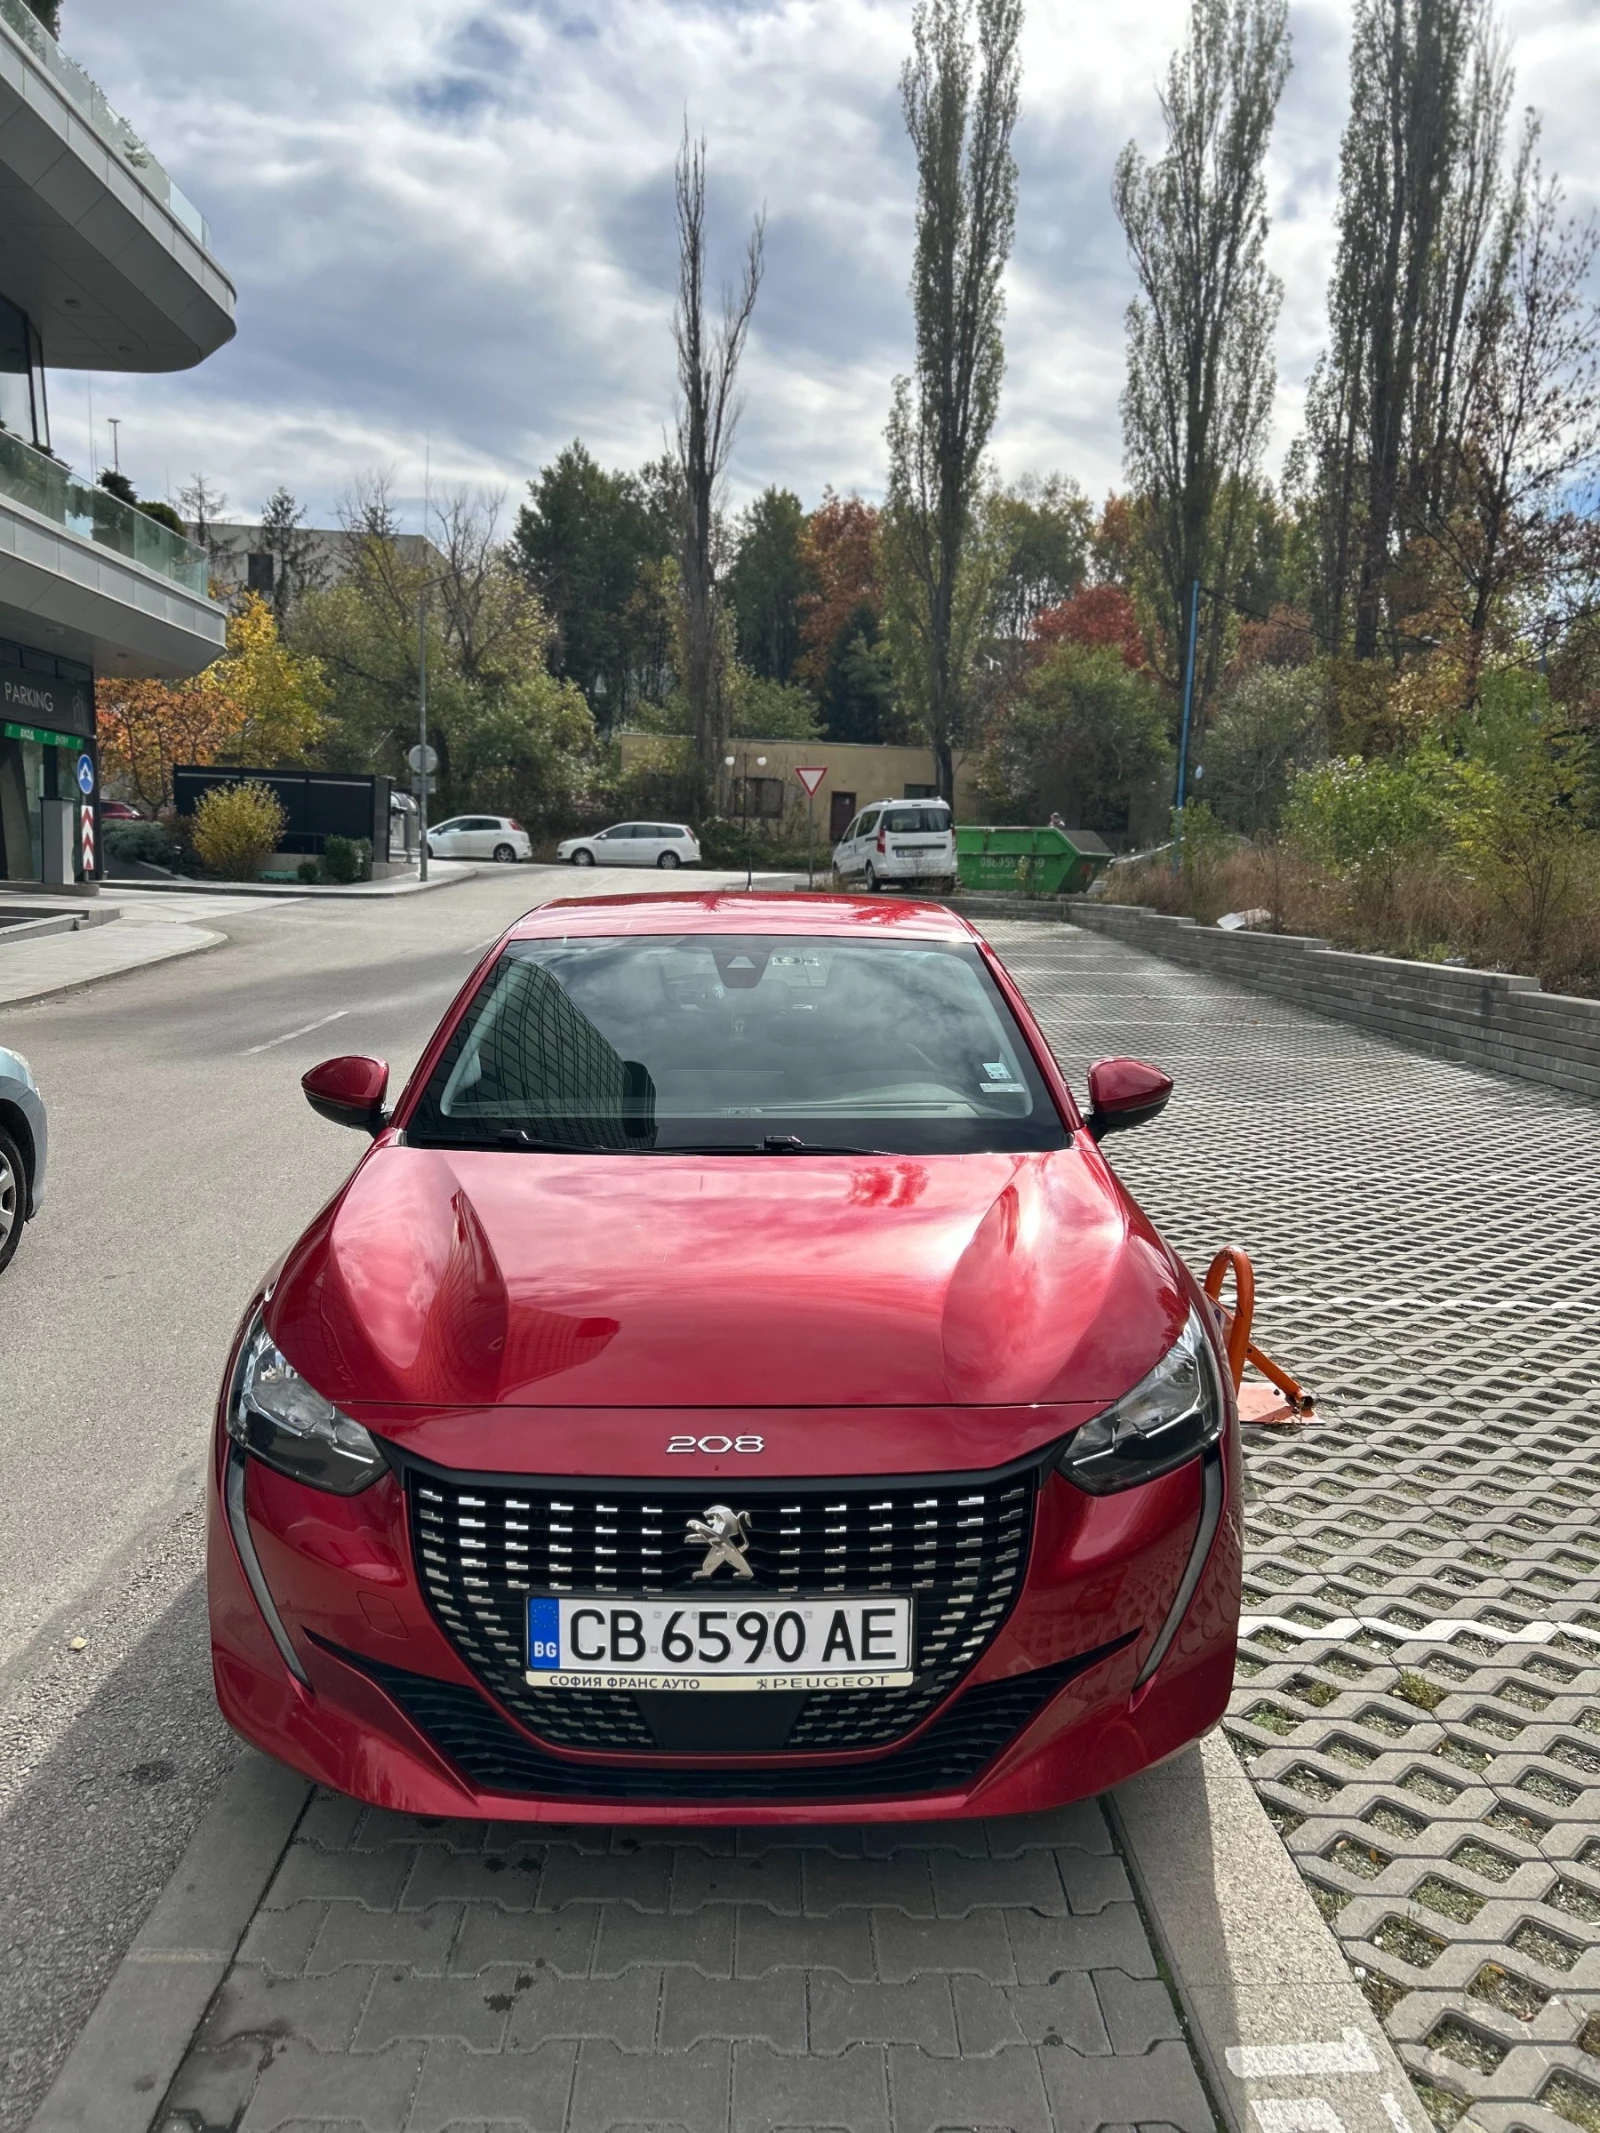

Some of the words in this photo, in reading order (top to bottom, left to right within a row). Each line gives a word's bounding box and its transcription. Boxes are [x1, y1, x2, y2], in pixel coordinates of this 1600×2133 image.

[5, 682, 53, 711] PARKING
[665, 1435, 765, 1455] 208
[570, 1608, 647, 1662] CB
[661, 1610, 806, 1663] 6590
[821, 1607, 897, 1662] AE
[533, 1641, 558, 1658] BG
[549, 1675, 603, 1688] СОФИЯ
[606, 1676, 659, 1690] ФРАНС
[661, 1678, 701, 1690] АУТО
[772, 1675, 890, 1689] PEUGEOT
